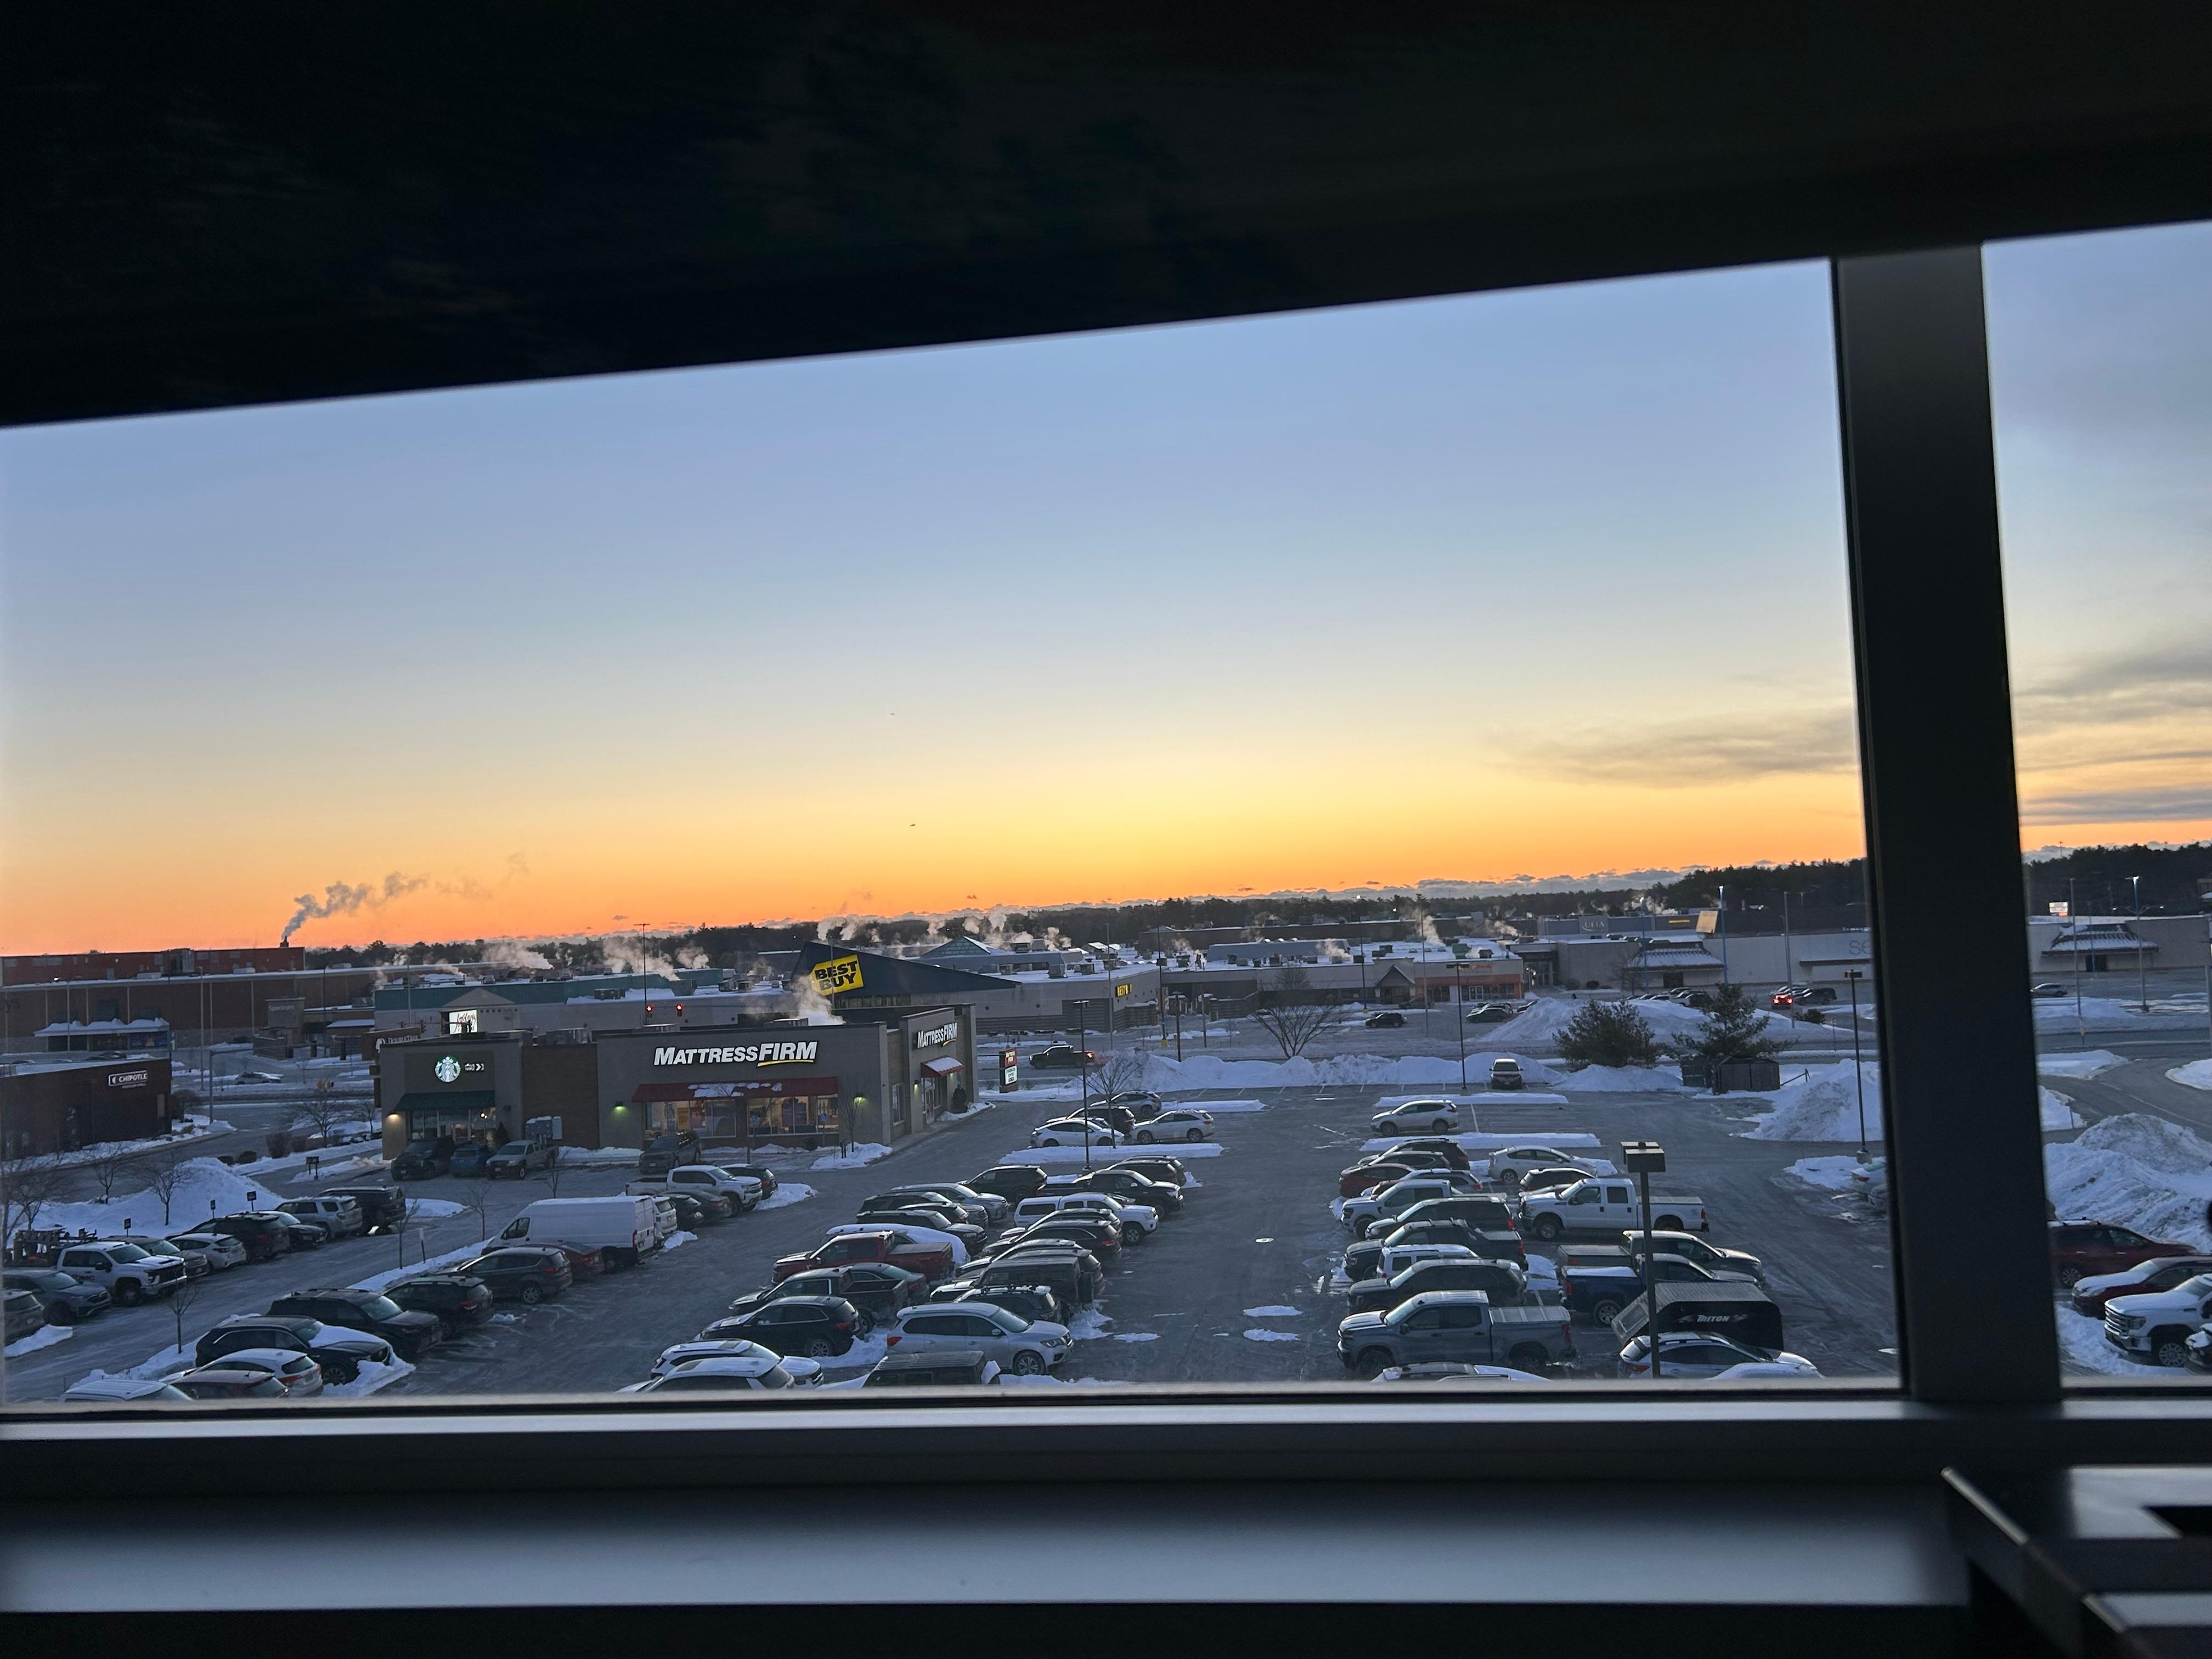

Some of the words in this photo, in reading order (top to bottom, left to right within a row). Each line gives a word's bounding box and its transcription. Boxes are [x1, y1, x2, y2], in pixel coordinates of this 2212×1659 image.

[815, 961, 857, 980] BEST
[819, 973, 856, 991] BUY
[119, 1073, 148, 1082] CHIPOTLE
